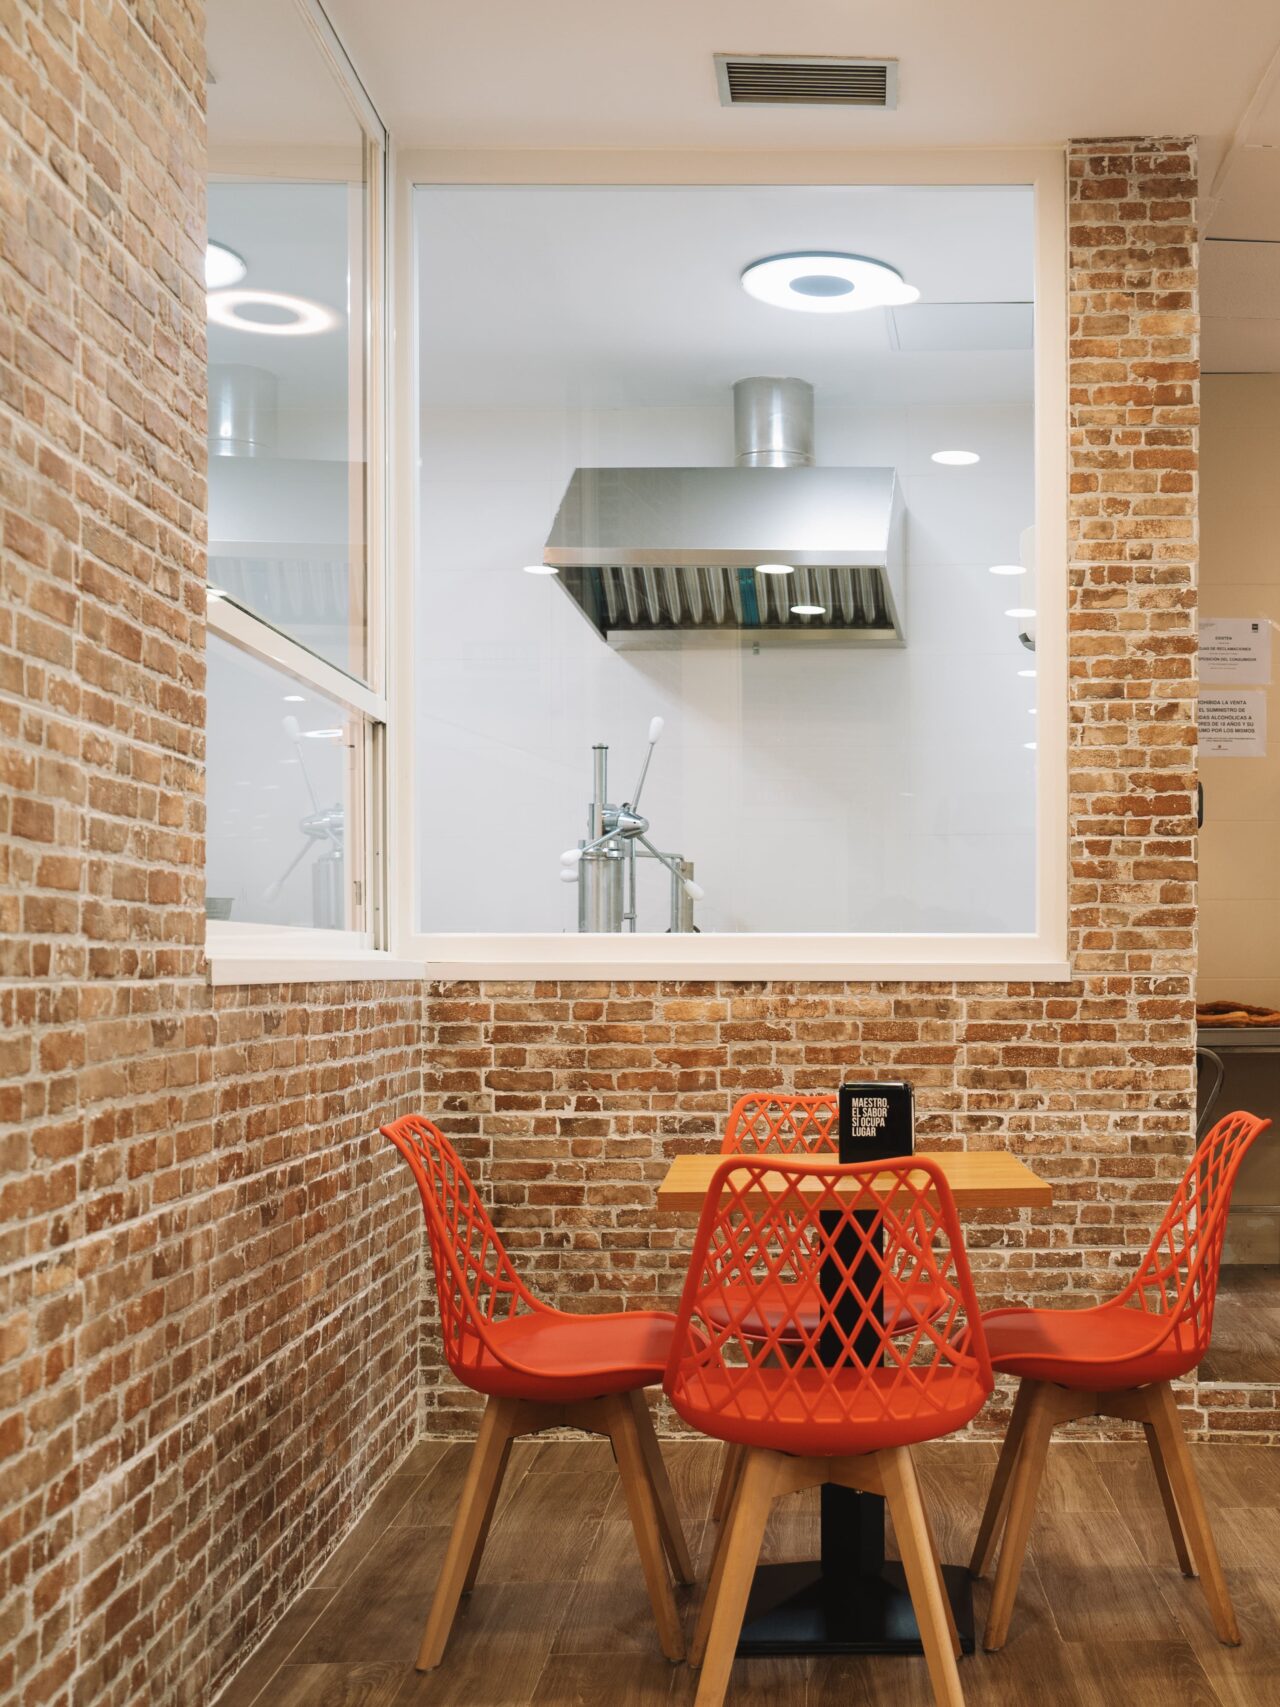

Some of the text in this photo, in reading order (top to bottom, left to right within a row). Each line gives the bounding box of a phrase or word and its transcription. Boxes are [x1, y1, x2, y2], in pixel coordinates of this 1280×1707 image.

[852, 1097, 890, 1108] MAESTRO,
[852, 1107, 887, 1117] EL SABOR
[860, 1117, 885, 1127] OCUPA
[852, 1127, 876, 1136] LUGAR
